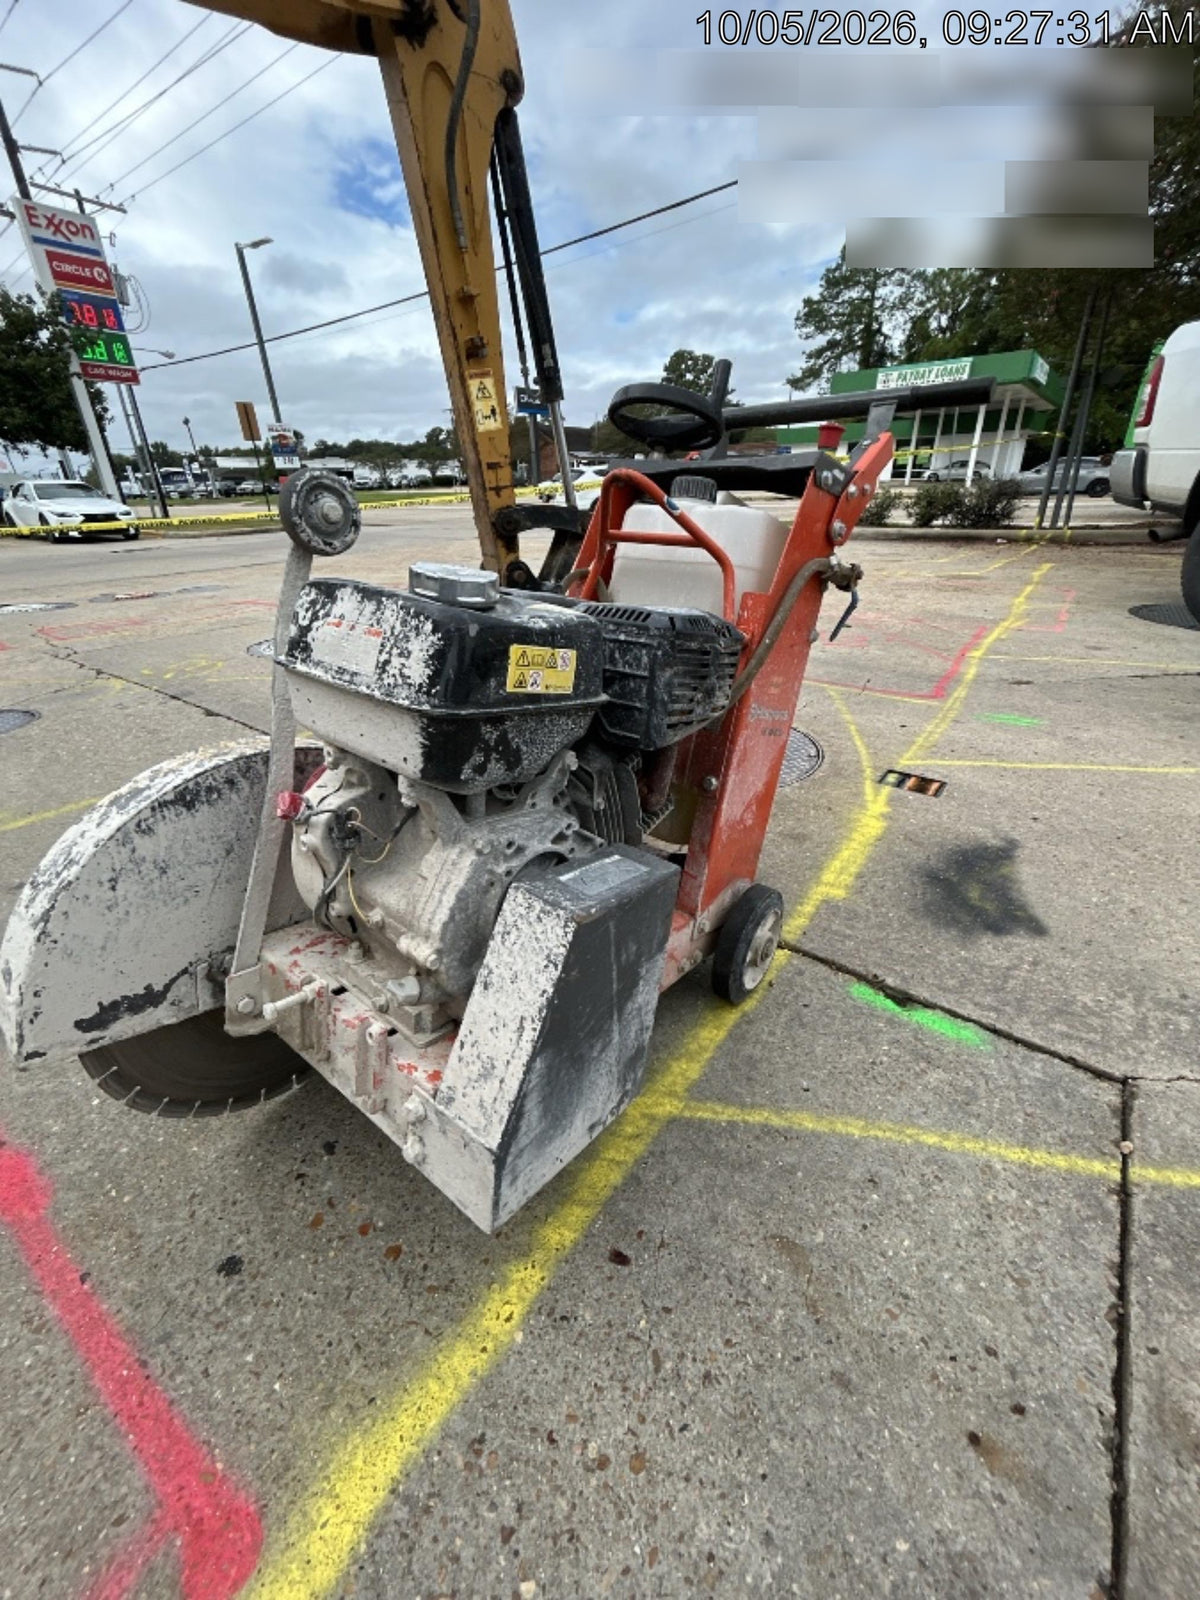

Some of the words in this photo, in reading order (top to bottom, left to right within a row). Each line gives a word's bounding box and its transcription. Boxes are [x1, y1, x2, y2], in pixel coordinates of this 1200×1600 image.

[24, 204, 95, 242] Exxon
[52, 260, 92, 279] CIRCLE
[896, 368, 934, 383] PAYDAY
[935, 363, 968, 379] LOANS
